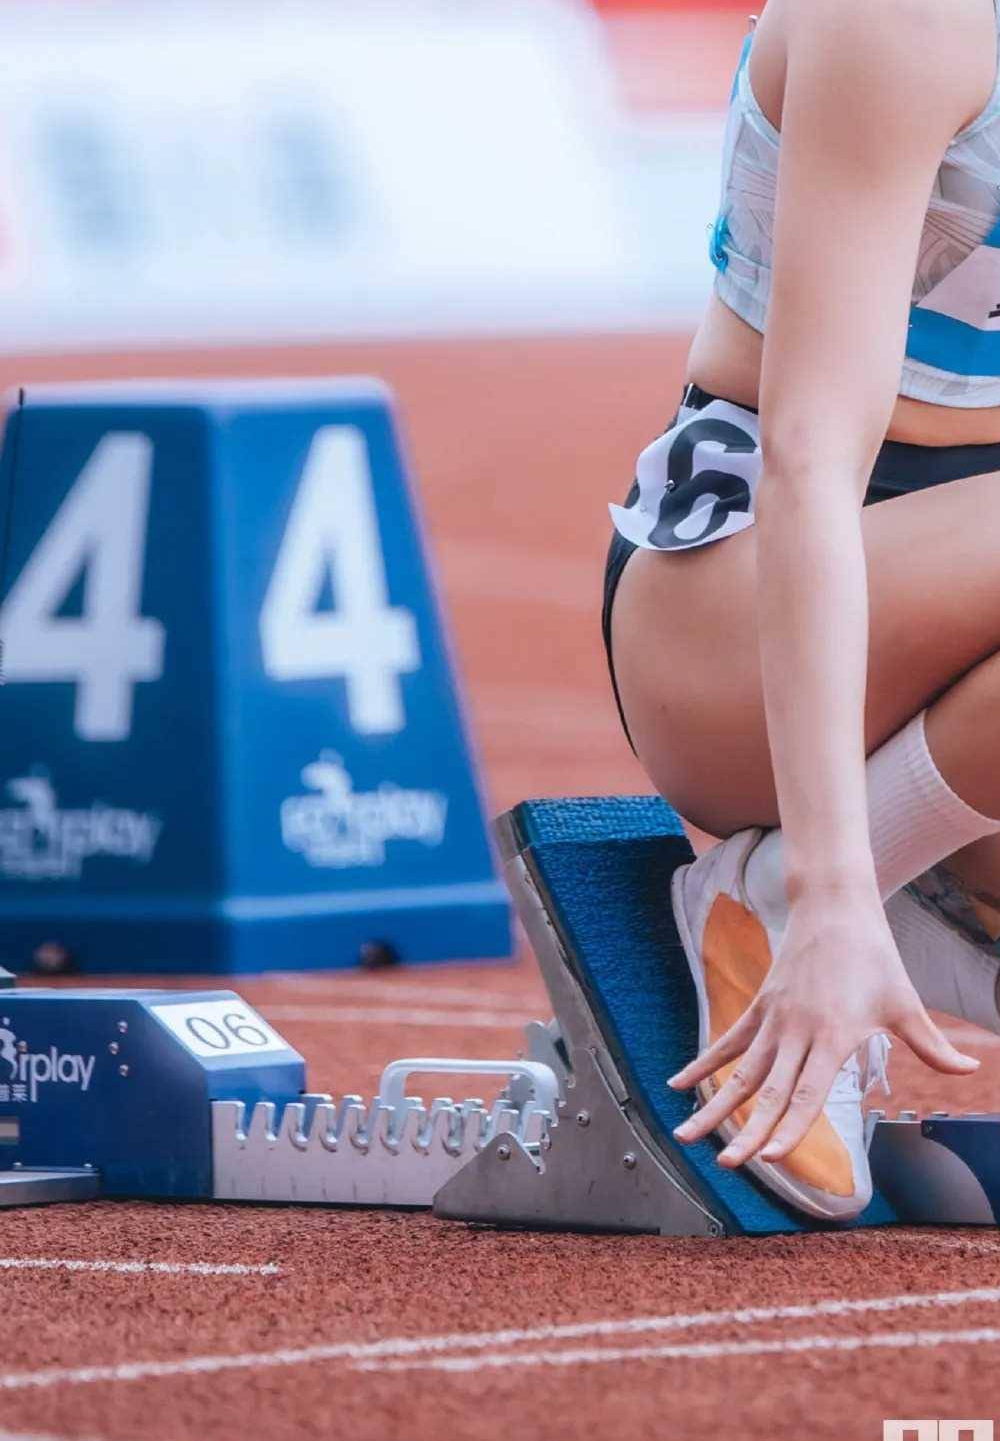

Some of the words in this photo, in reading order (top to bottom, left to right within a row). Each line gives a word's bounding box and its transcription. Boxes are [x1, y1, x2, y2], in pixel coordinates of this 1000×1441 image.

[0, 431, 165, 741] 4
[258, 424, 421, 735] 4
[648, 418, 757, 548] 6
[186, 1013, 269, 1050] 06
